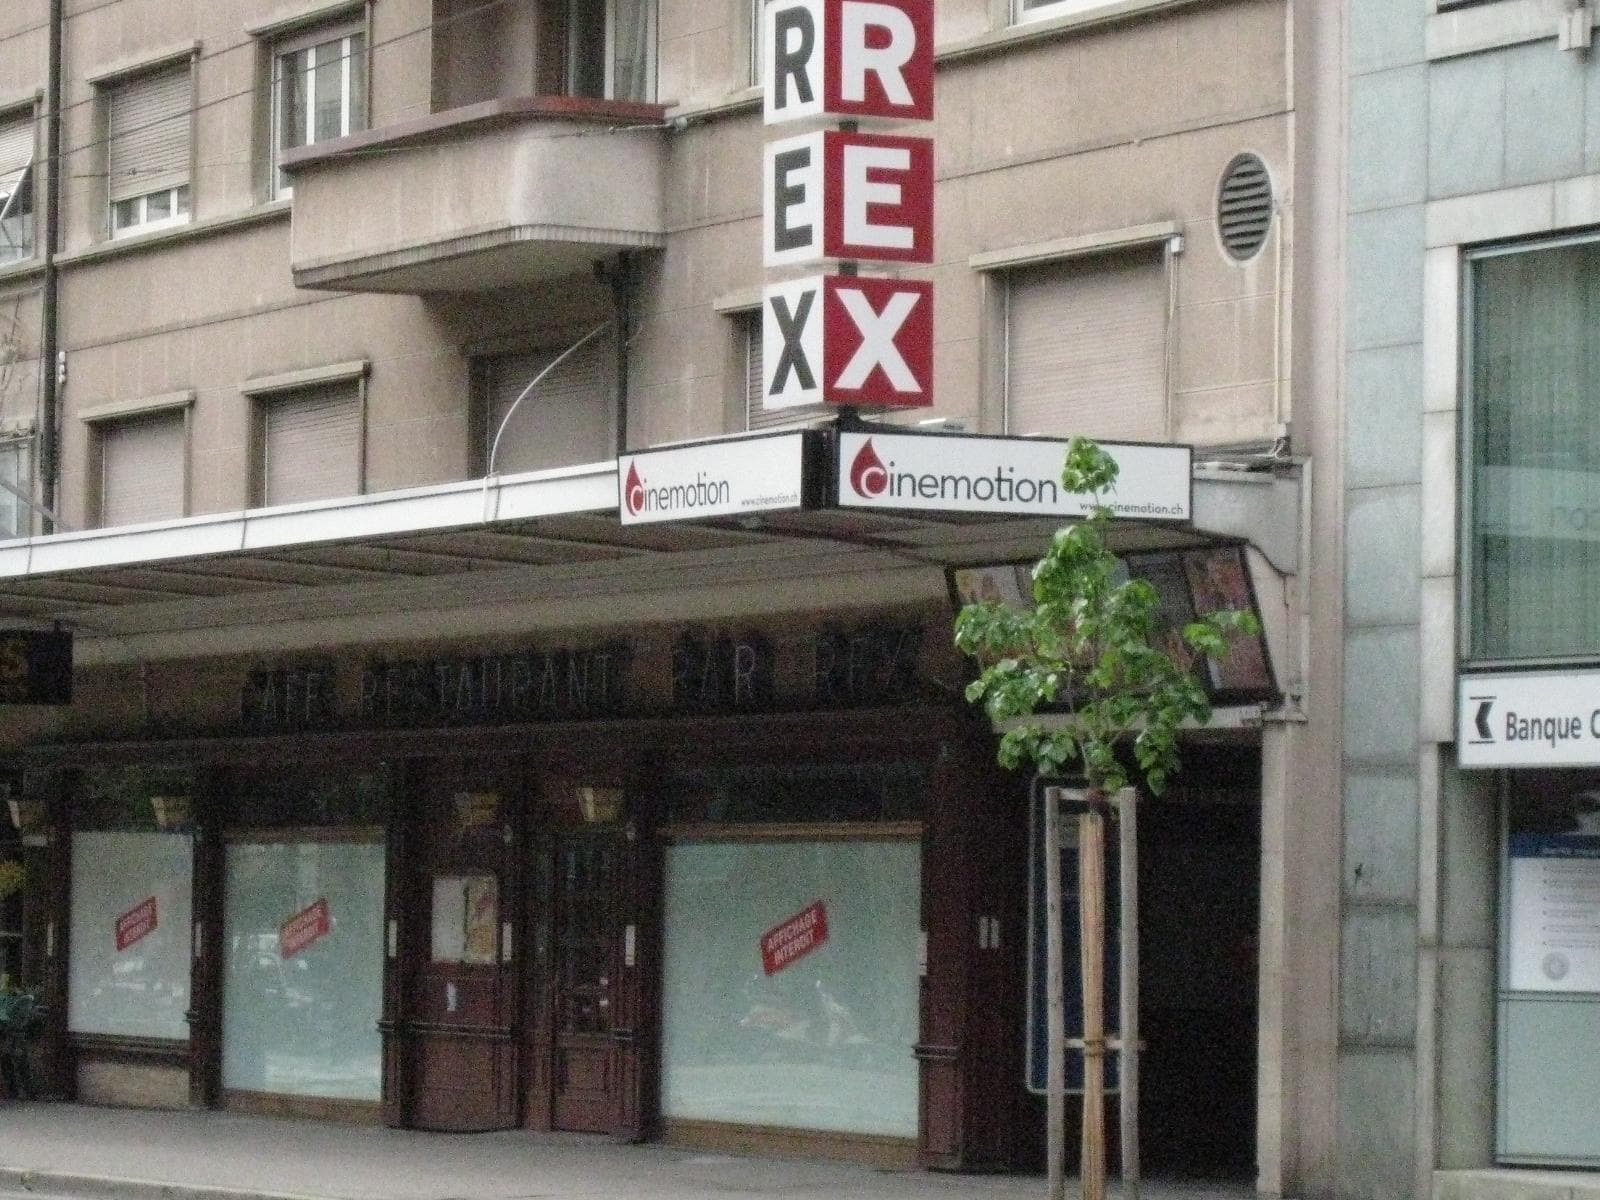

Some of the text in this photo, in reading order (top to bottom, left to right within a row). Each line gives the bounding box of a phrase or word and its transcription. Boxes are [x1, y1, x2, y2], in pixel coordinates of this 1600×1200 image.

[769, 5, 818, 396] REX
[833, 0, 923, 393] REX
[630, 471, 730, 514] cinemotion
[860, 460, 1058, 504] cinemotion
[1080, 501, 1184, 515] wwcinemotion.ch
[1506, 711, 1582, 748] Banque
